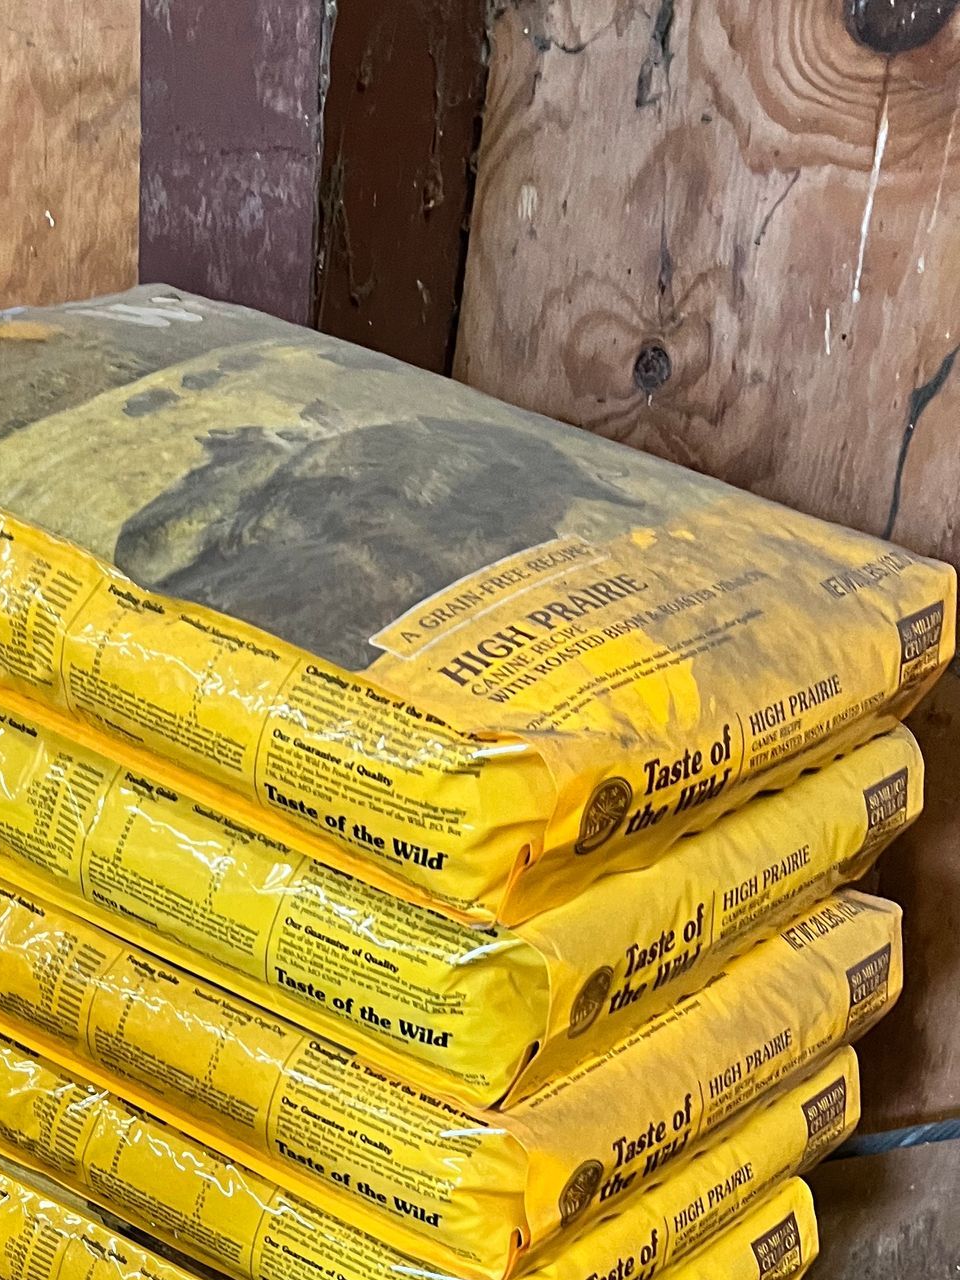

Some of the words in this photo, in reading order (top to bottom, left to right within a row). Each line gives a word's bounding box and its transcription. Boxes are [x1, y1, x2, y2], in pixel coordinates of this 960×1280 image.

[400, 631, 420, 643] A
[419, 565, 530, 631] GRAIN-FREE
[437, 626, 537, 686] HIGH
[525, 573, 649, 630] PRAIRIE
[471, 654, 535, 696] CANINE
[535, 623, 589, 660] RECIPE
[489, 673, 536, 704] WITH
[539, 634, 605, 676] ROASTED
[607, 611, 649, 638] BISON
[748, 704, 786, 737] HIGH
[788, 673, 843, 716] PRAIRIE
[643, 750, 703, 796] Taste
[710, 724, 732, 764] of
[264, 783, 318, 819] Taste
[324, 812, 347, 834] of
[352, 824, 385, 850] the
[392, 837, 446, 871] Wild
[722, 878, 758, 911] HIGH
[762, 844, 810, 889] PRAIRIE
[284, 916, 302, 932] Our
[364, 951, 399, 973] Quality
[624, 930, 675, 978] Taste
[683, 903, 704, 944] of
[274, 967, 326, 1001] Taste
[332, 996, 354, 1014] of
[359, 1005, 392, 1030] the
[399, 1018, 450, 1048] Wild
[708, 1064, 743, 1098] HIGH
[746, 1028, 793, 1075] PRAIRIE
[612, 1119, 666, 1167] Taste
[672, 1094, 693, 1135] of
[275, 1139, 326, 1175] Taste
[331, 1171, 351, 1189] of
[357, 1181, 387, 1204] the
[393, 1197, 440, 1228] Wild
[674, 1197, 705, 1232] HIGH
[707, 1162, 754, 1209] PRAIRIE
[640, 1228, 659, 1267] of
